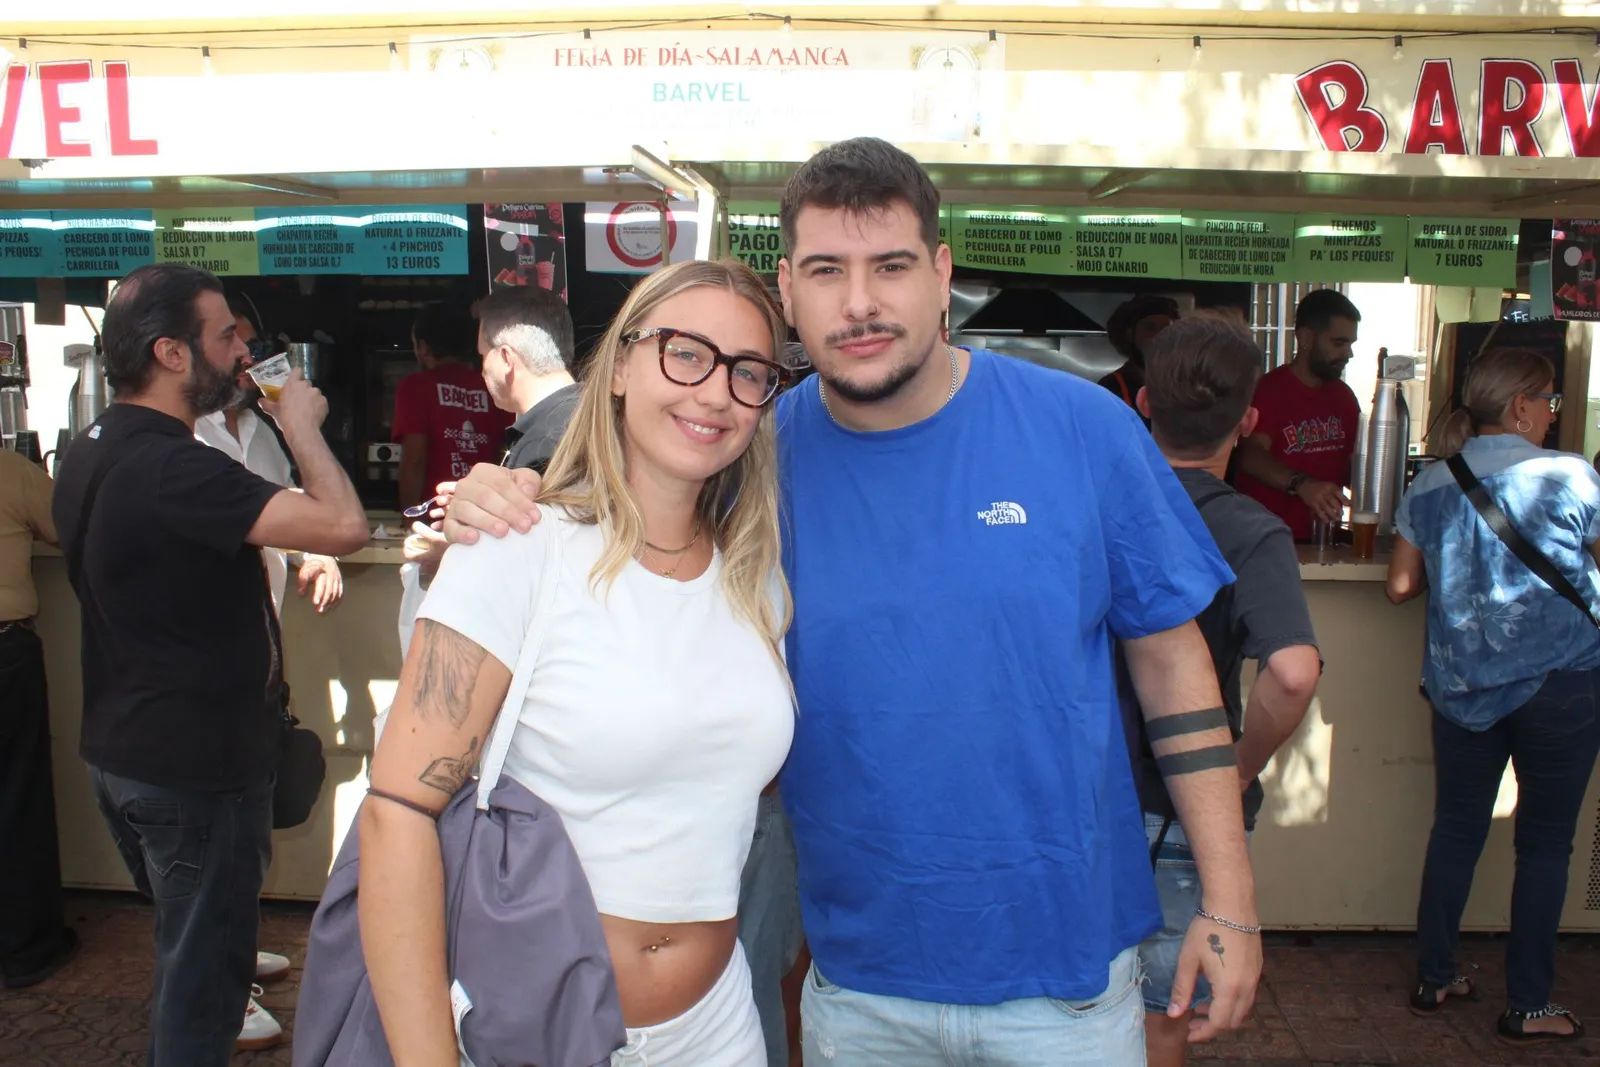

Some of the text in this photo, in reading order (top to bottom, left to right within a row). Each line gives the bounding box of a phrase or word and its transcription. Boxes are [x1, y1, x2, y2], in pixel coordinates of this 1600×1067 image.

[554, 47, 612, 67] FERIA
[623, 47, 648, 66] DE
[652, 82, 751, 102] BARVEL
[969, 214, 1012, 225] NUESTRAS
[1087, 218, 1126, 227] NUESTRAS
[1206, 221, 1234, 233] PINCHO
[1235, 222, 1246, 233] DE
[1331, 220, 1377, 232] TENEMOS
[1423, 224, 1507, 236] BOTELLA DE SIDRA
[63, 232, 150, 243] CABECERO DE LOMO
[215, 231, 227, 242] DE
[229, 230, 255, 242] MORA
[365, 227, 464, 238] NATURAL O FRIZZANTE
[965, 228, 1062, 241] CABECERO DE LOMO
[1076, 231, 1178, 245] REDUCCION DE MORA
[390, 242, 396, 252] 4
[400, 241, 444, 252] PINCHOS
[729, 233, 780, 251] PAGO
[1251, 237, 1290, 249] HORNEADA
[1323, 235, 1382, 247] MINIPIZZAS
[1414, 238, 1456, 249] NATURAL
[1467, 240, 1515, 251] FRIZZANTE
[65, 246, 150, 257] PECHUGA DE POLLO
[163, 246, 191, 258] SALSA
[299, 243, 307, 254] DE
[345, 243, 354, 254] DE
[965, 241, 1062, 255] PECHUGA DE POLLO
[1076, 246, 1106, 258] SALSA
[308, 256, 329, 267] SALSA
[966, 254, 1027, 267] CARRILLERA
[1189, 249, 1198, 259] DE
[1238, 250, 1248, 261] DE
[1249, 251, 1269, 262] LOMO
[1271, 251, 1286, 262] CON
[1329, 250, 1349, 261] LOS
[1435, 253, 1483, 267] 7 EUROS
[66, 261, 120, 271] CARRILLERA
[386, 256, 441, 269] 13 EUROS
[1076, 260, 1149, 273] MOJO CANARIO
[1242, 263, 1252, 275] DE
[1253, 264, 1274, 275] MORA
[990, 501, 1009, 511] THE
[977, 508, 1010, 520] NORTH
[986, 516, 1010, 526] FACE
